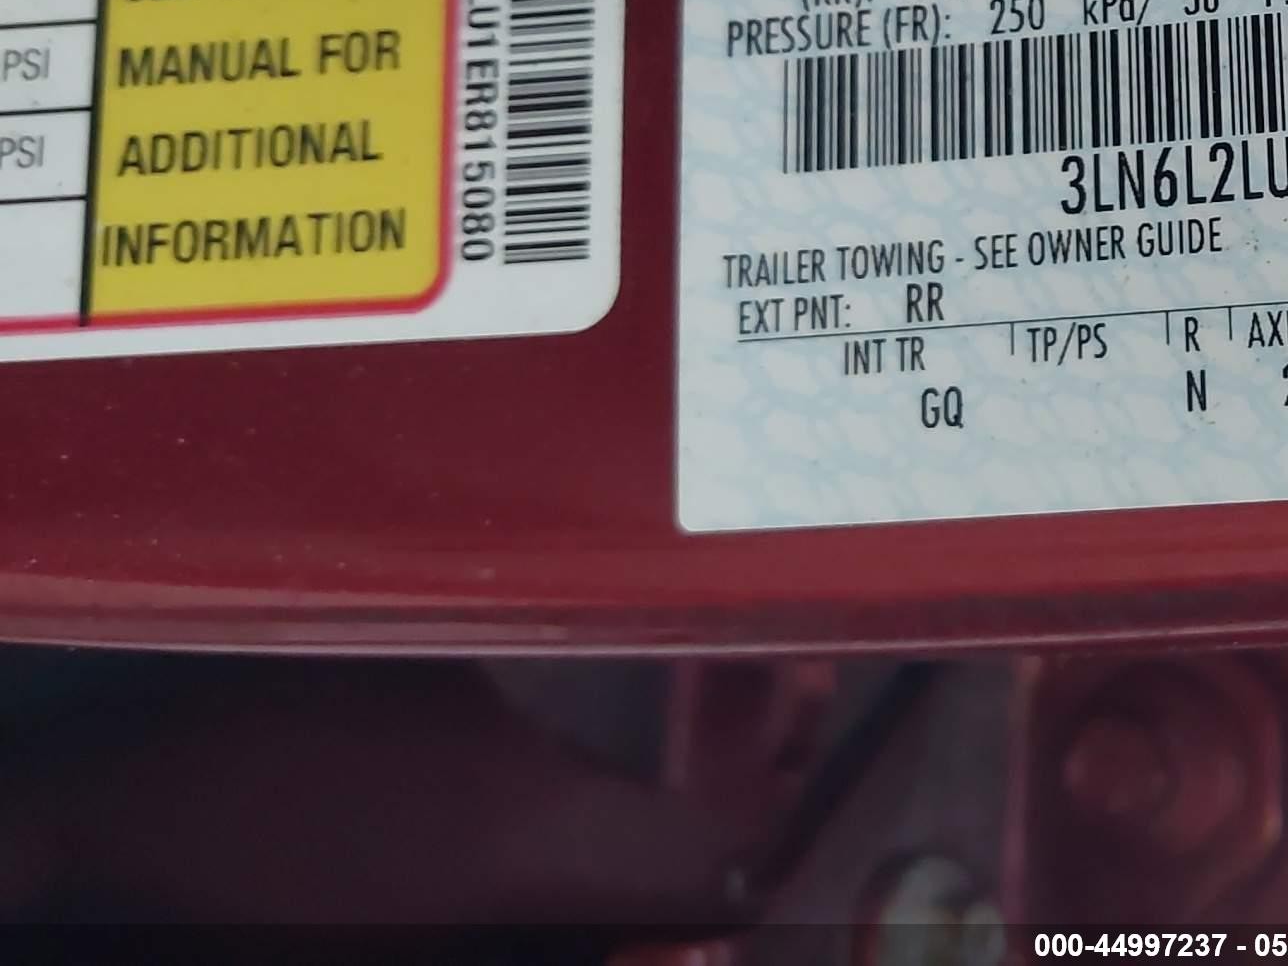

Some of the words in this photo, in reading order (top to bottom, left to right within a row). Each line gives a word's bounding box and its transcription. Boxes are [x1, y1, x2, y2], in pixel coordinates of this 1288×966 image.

[118, 38, 300, 88] MANUAL
[317, 29, 401, 74] FOR
[727, 10, 873, 56] PRESSURE
[884, 4, 950, 47] (FR):
[2, 47, 50, 83] PSI
[0, 136, 44, 170] PSI
[117, 120, 383, 177] ADDITIONAL
[101, 208, 407, 268] INFORMATION
[723, 249, 826, 289] TRAILER
[837, 240, 945, 280] TOWING
[974, 235, 1018, 270] SEE
[1027, 226, 1126, 267] OWNER
[1137, 218, 1222, 256] GUIDE
[739, 298, 785, 334] EXT
[794, 294, 851, 329] PNT:
[907, 282, 944, 323] RR
[843, 339, 885, 375] INT
[896, 337, 925, 372] TR
[1026, 322, 1108, 366] TP/PS
[1184, 317, 1200, 352] R
[921, 386, 963, 428] GQ
[1186, 370, 1207, 412] N
